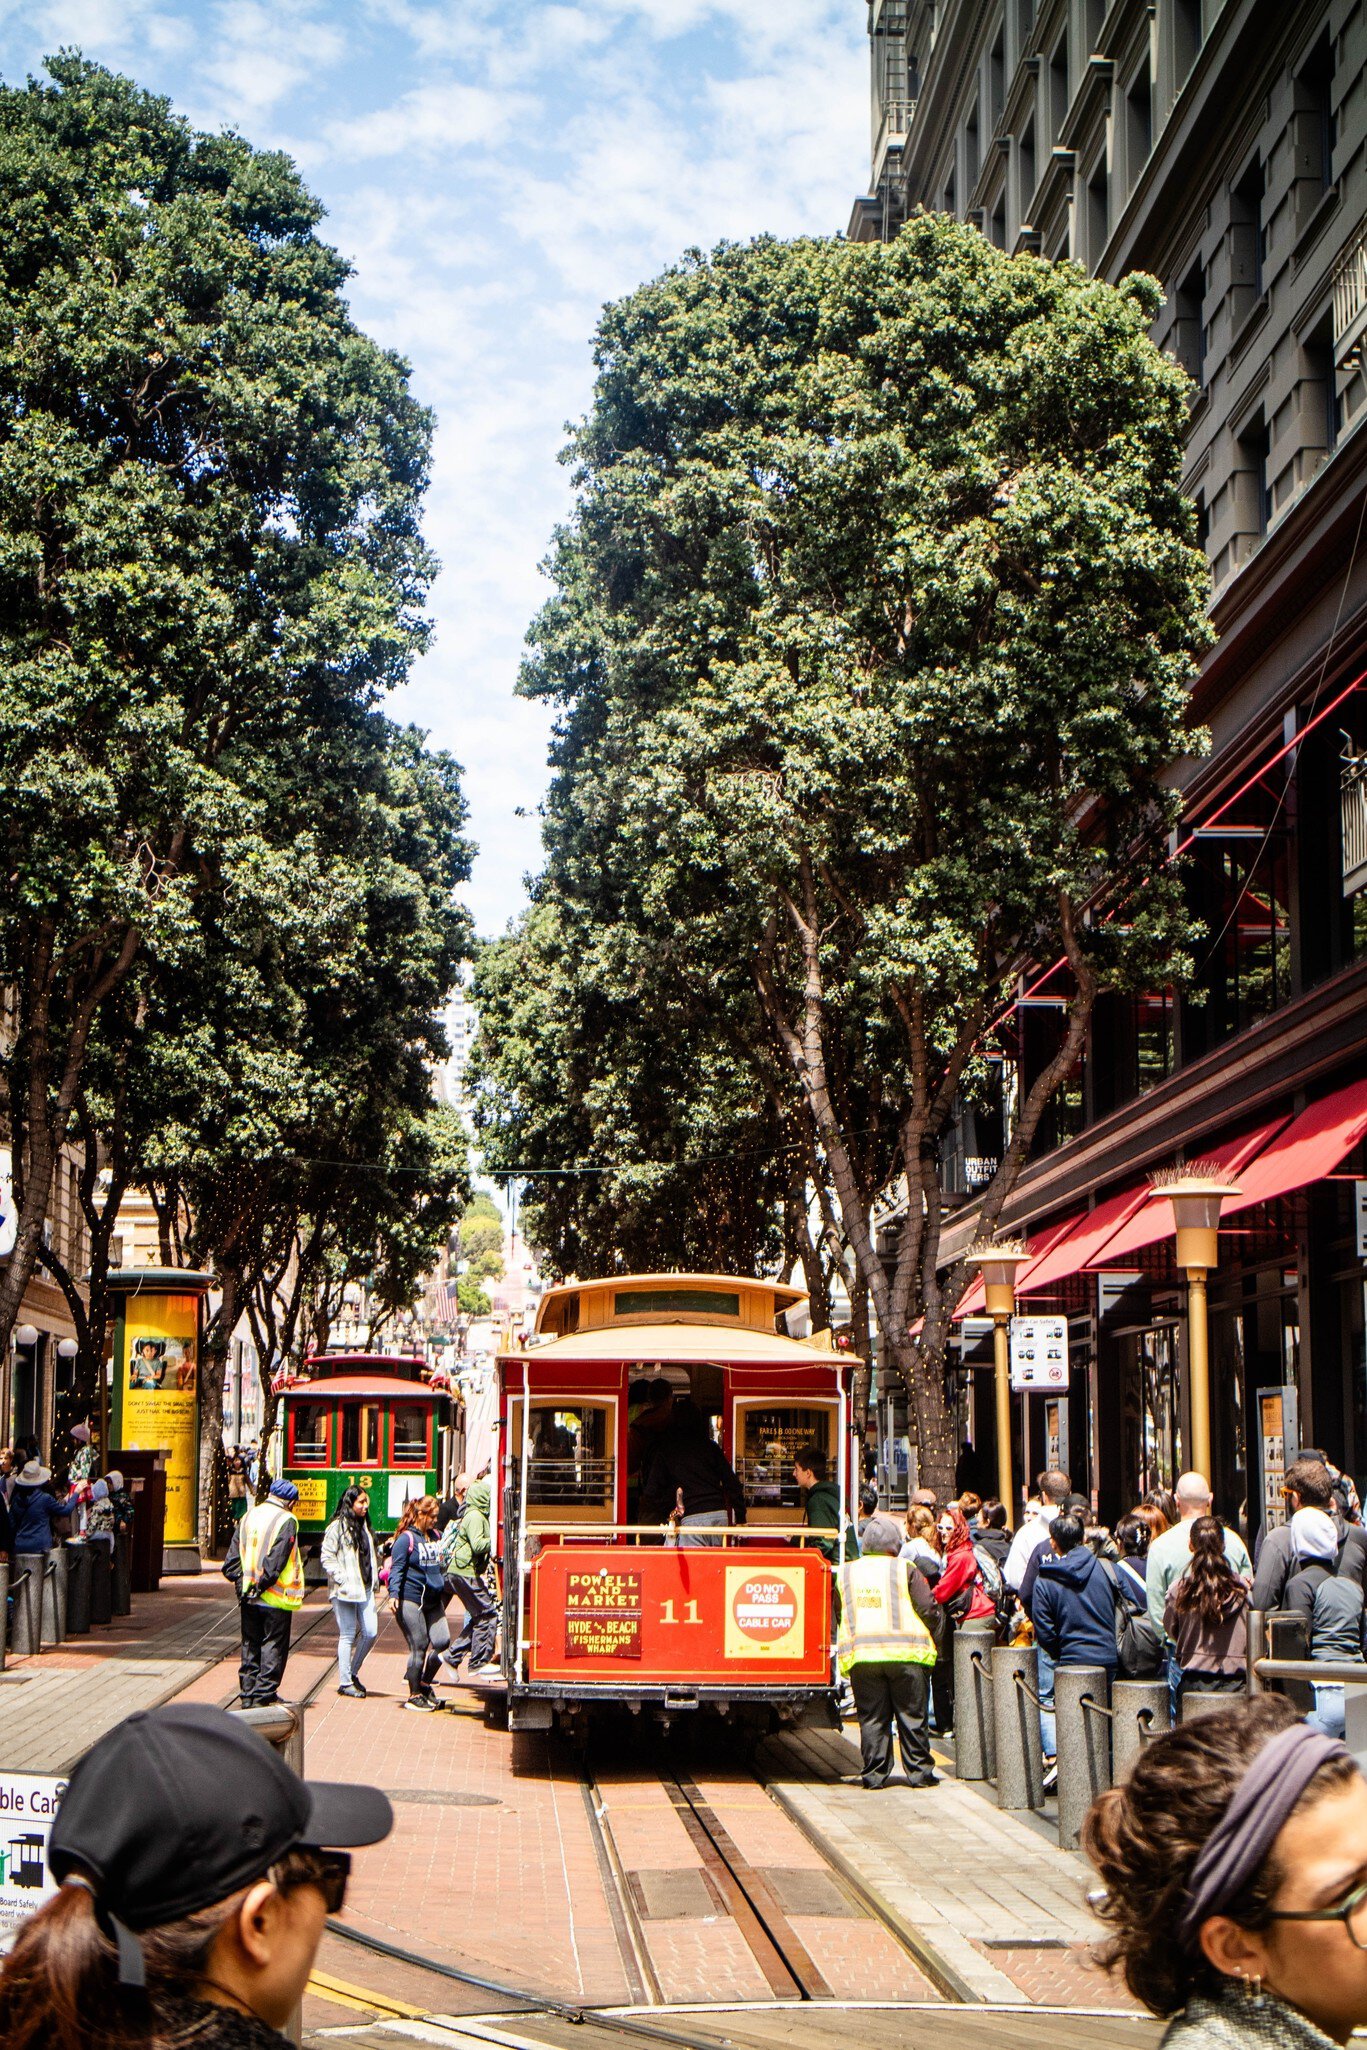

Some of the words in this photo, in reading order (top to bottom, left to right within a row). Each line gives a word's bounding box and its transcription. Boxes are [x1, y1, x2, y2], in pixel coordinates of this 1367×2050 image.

[965, 1157, 997, 1165] URBAN
[965, 1165, 998, 1173] OUTFIT
[966, 1173, 990, 1181] TERS
[348, 1475, 373, 1488] 13
[570, 1575, 639, 1587] POWELL
[587, 1586, 621, 1595] AND
[746, 1584, 762, 1594] DO
[763, 1584, 786, 1594] NOT
[568, 1595, 639, 1606] MARKET
[752, 1593, 779, 1603] PASS
[660, 1599, 703, 1624] 11
[568, 1621, 592, 1634] HYDE
[606, 1621, 637, 1634] BEACH
[738, 1618, 769, 1628] CABLE
[771, 1618, 791, 1628] CAR
[573, 1635, 631, 1644] FISHERMANS
[587, 1644, 617, 1653] WHARF
[30, 1791, 58, 1814] Car
[0, 1897, 17, 1907] Board
[19, 1900, 38, 1911] Safely
